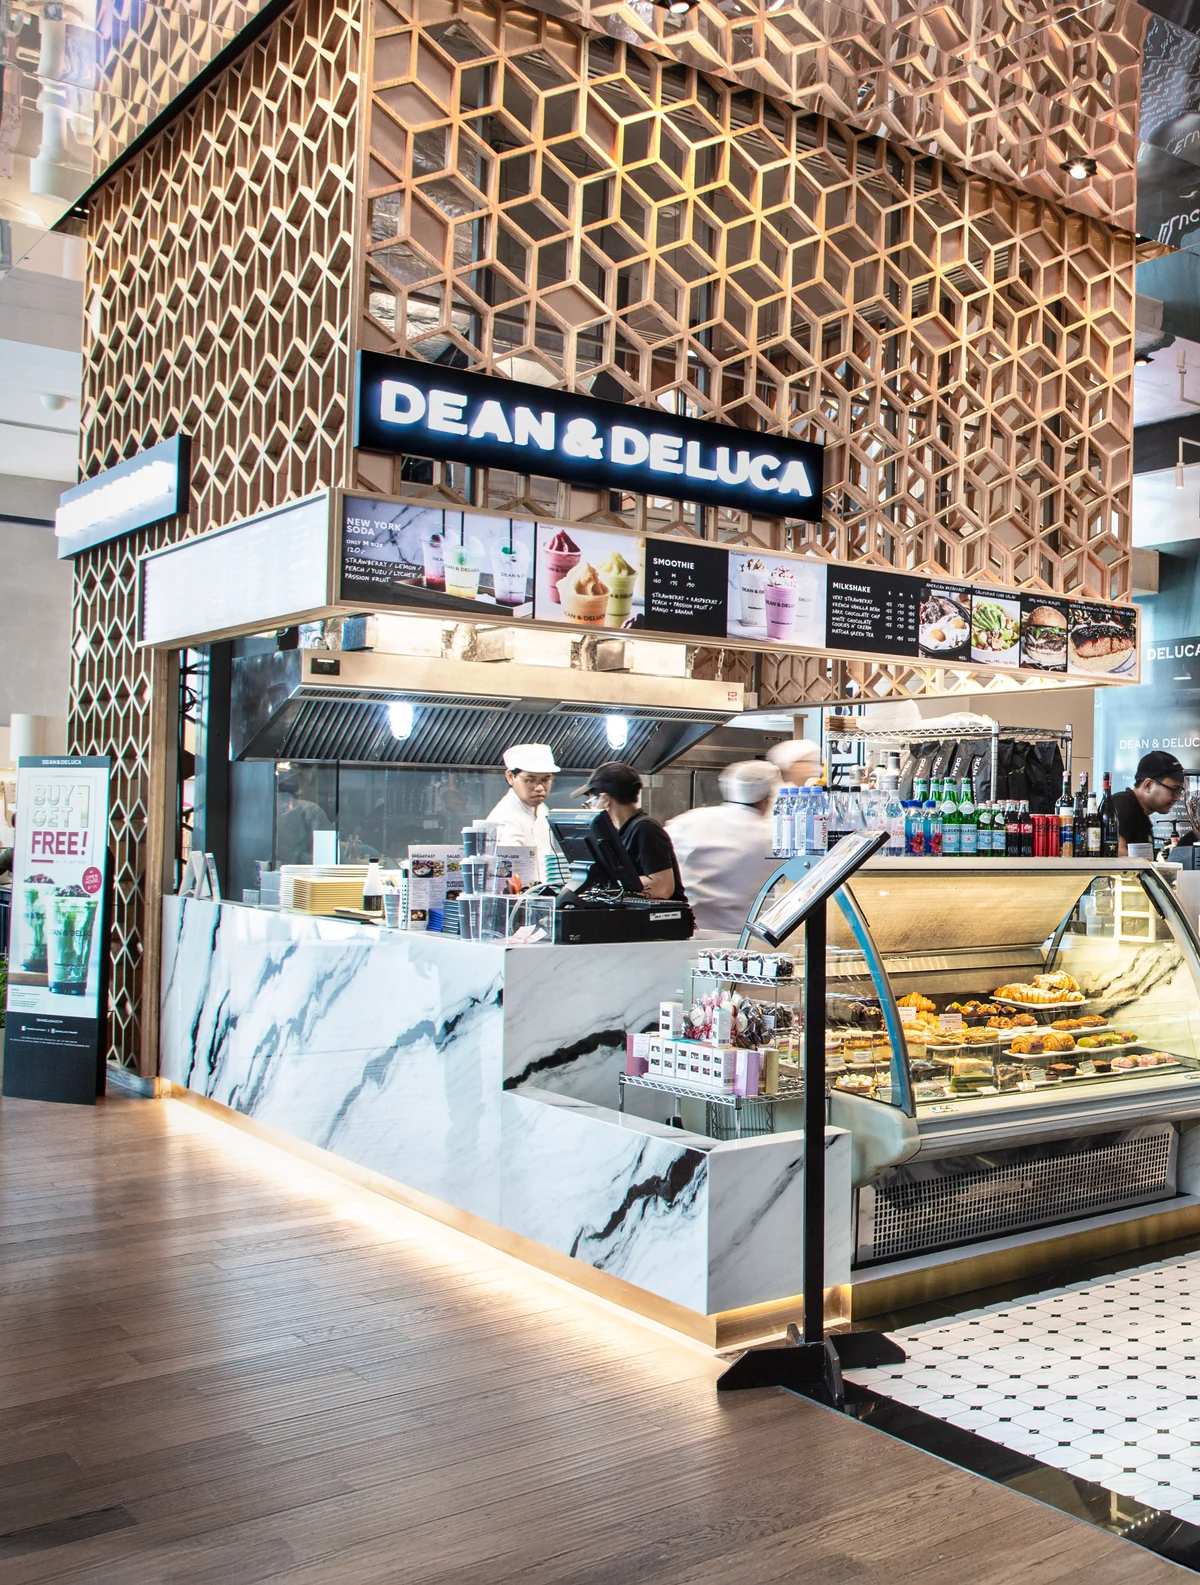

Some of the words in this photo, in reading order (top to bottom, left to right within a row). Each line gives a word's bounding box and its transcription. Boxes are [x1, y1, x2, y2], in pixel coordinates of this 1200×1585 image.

[380, 379, 555, 452] DEAN
[610, 425, 813, 498] DELUCA
[346, 517, 370, 527] NEW
[374, 521, 401, 531] YORK
[346, 526, 375, 535] SODA
[653, 558, 695, 570] SMOOTHIE
[832, 582, 871, 593] MILKSHAKE
[1120, 739, 1149, 750] DEAN
[1152, 739, 1160, 749] &
[34, 784, 75, 806] BUY
[32, 807, 73, 828] GET
[31, 831, 88, 856] FREE!
